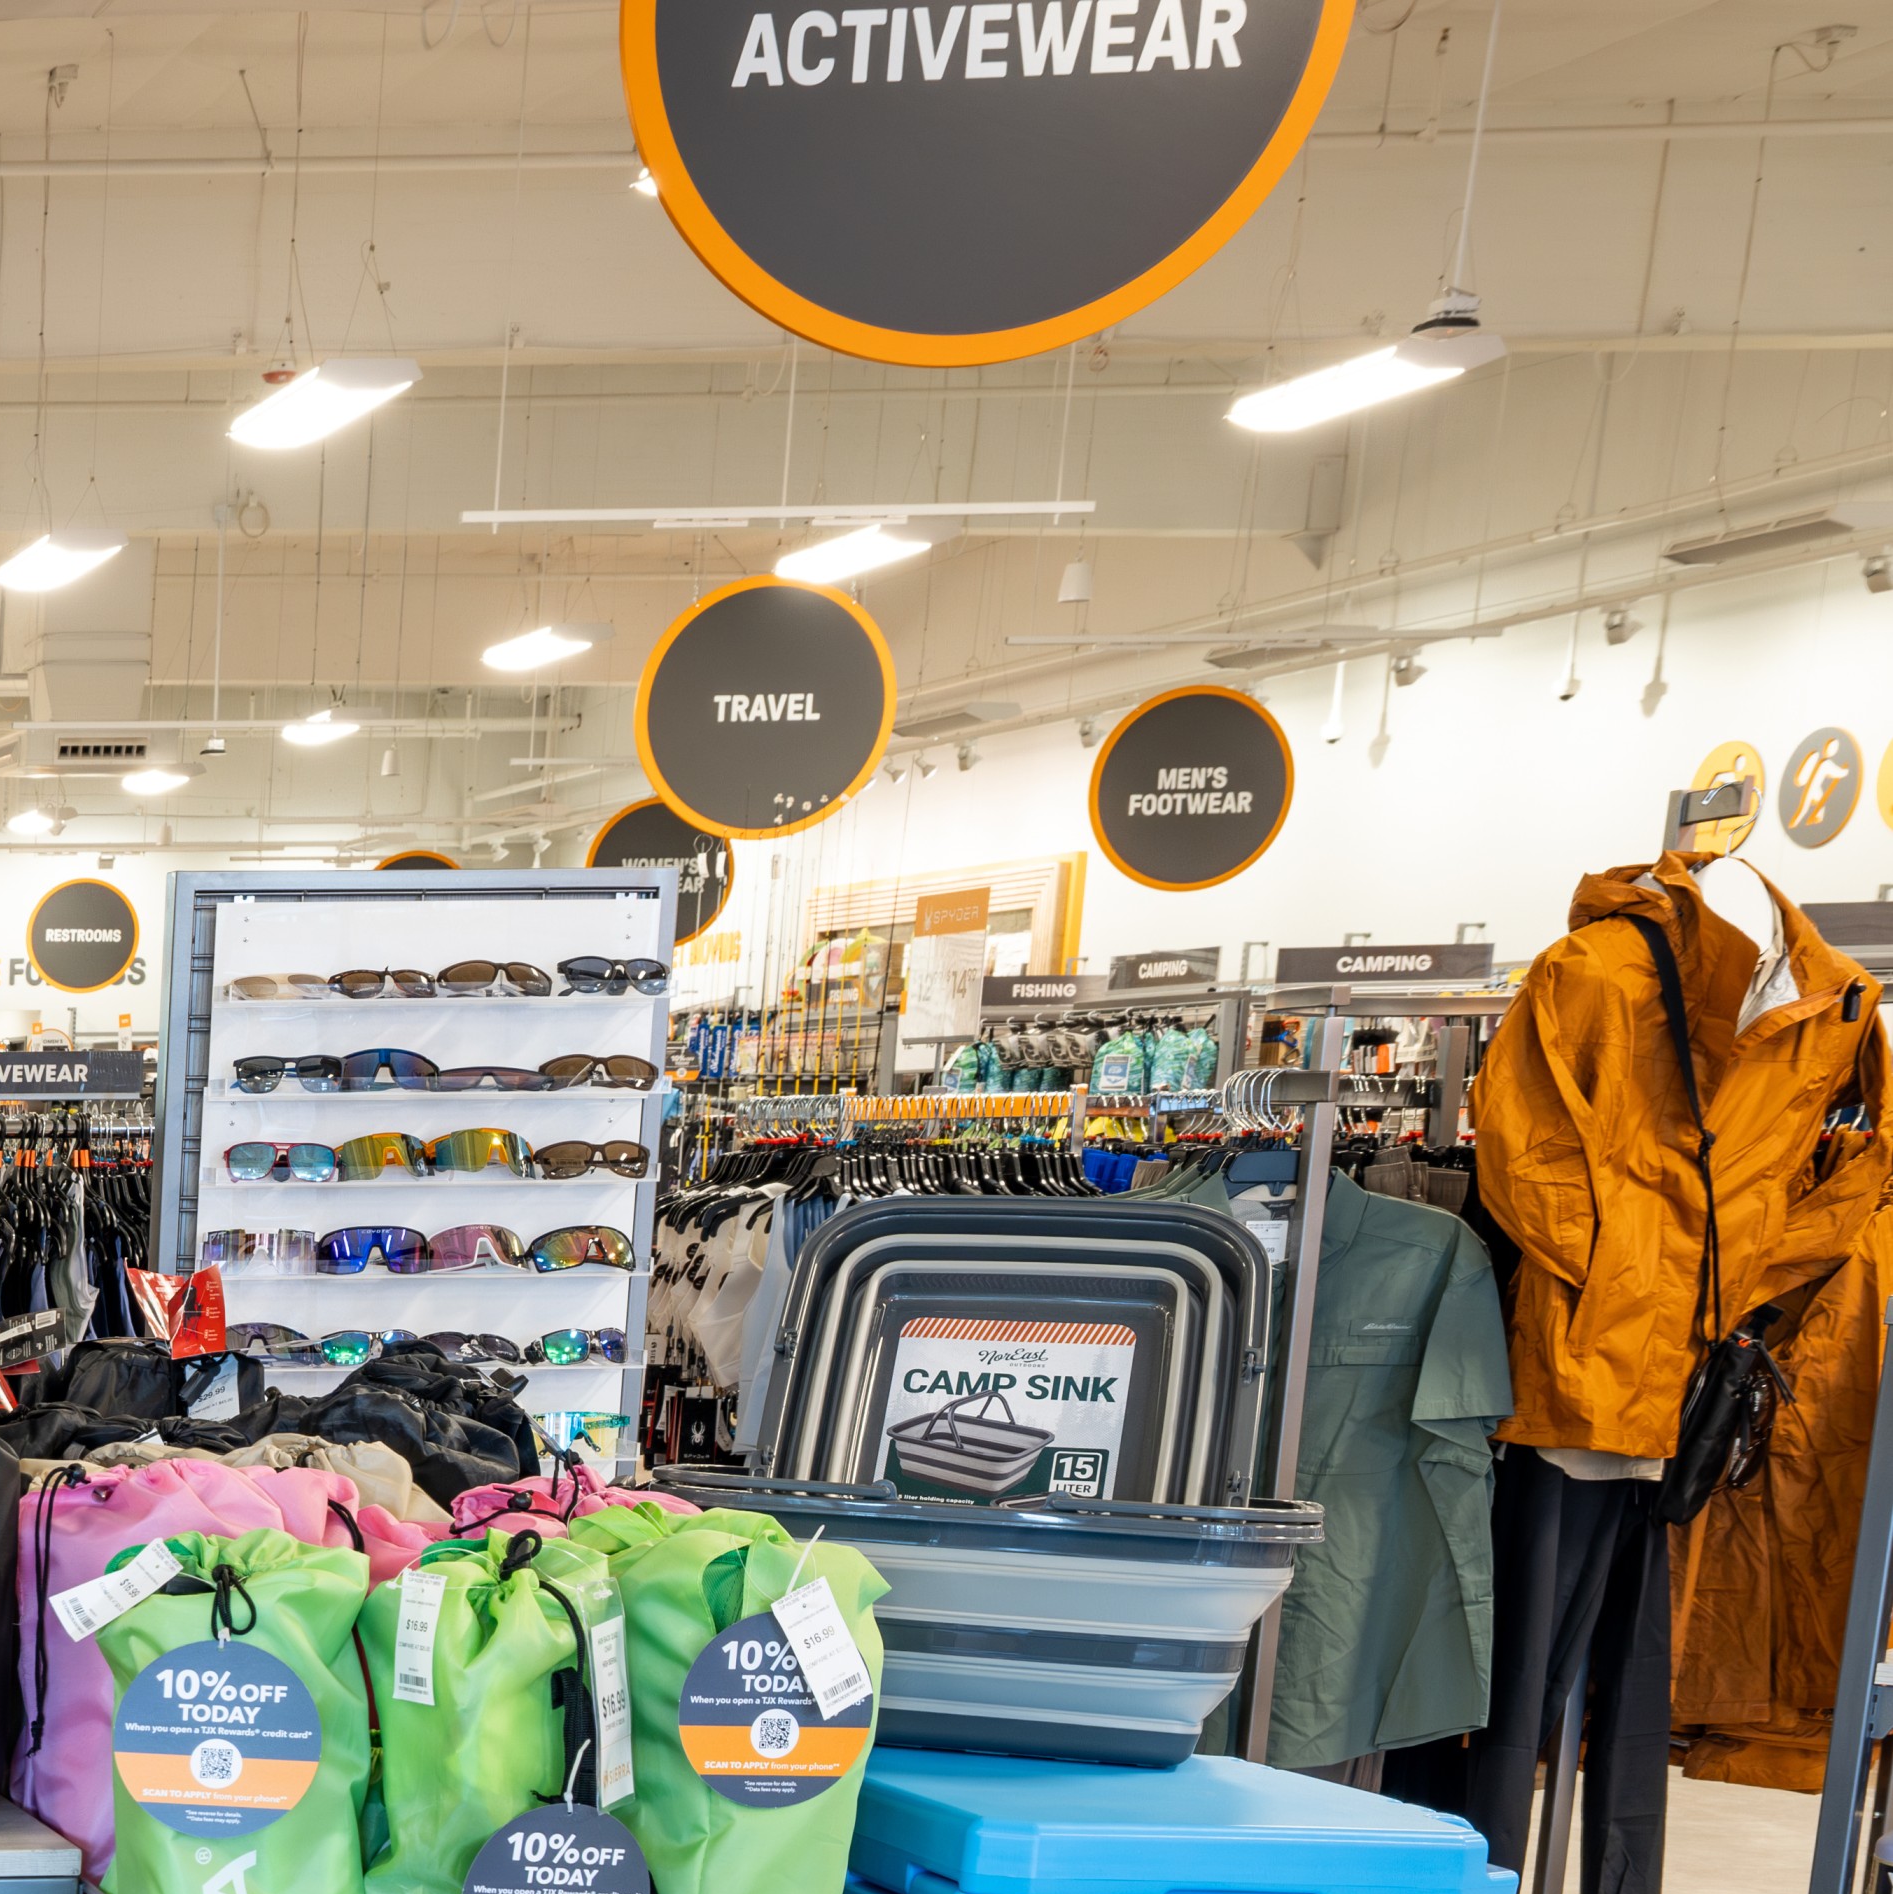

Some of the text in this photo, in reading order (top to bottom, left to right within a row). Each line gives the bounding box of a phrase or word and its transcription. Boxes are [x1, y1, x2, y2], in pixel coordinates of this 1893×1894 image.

[731, 2, 1245, 87] ACTIVEWEAR
[713, 693, 821, 722] TRAVEL
[1158, 765, 1228, 790] MEN'S
[1128, 790, 1252, 817] FOOTWEAR
[933, 904, 979, 924] SPYDER
[45, 928, 122, 943] RESTROOMS
[1139, 959, 1188, 979] CAMPING
[1336, 955, 1432, 973] CAMPING
[1012, 982, 1076, 998] FISHING
[978, 1348, 1049, 1366] NorEast
[903, 1368, 1119, 1402] CAMP SINK
[1059, 1456, 1094, 1478] 15
[1056, 1484, 1091, 1494] LITER
[406, 1619, 428, 1632] $16.99
[803, 1626, 835, 1649] $16.99
[722, 1640, 797, 1671] 10%
[156, 1669, 288, 1703] 10% OFF
[178, 1703, 261, 1724] TODAY
[602, 1689, 626, 1719] $16.99
[125, 1723, 151, 1732] When
[152, 1725, 168, 1733] you
[170, 1727, 192, 1735] open
[201, 1726, 216, 1734] TJX
[262, 1730, 287, 1738] credit
[507, 1832, 625, 1866] 10% OFF
[525, 1866, 598, 1886] TODAY
